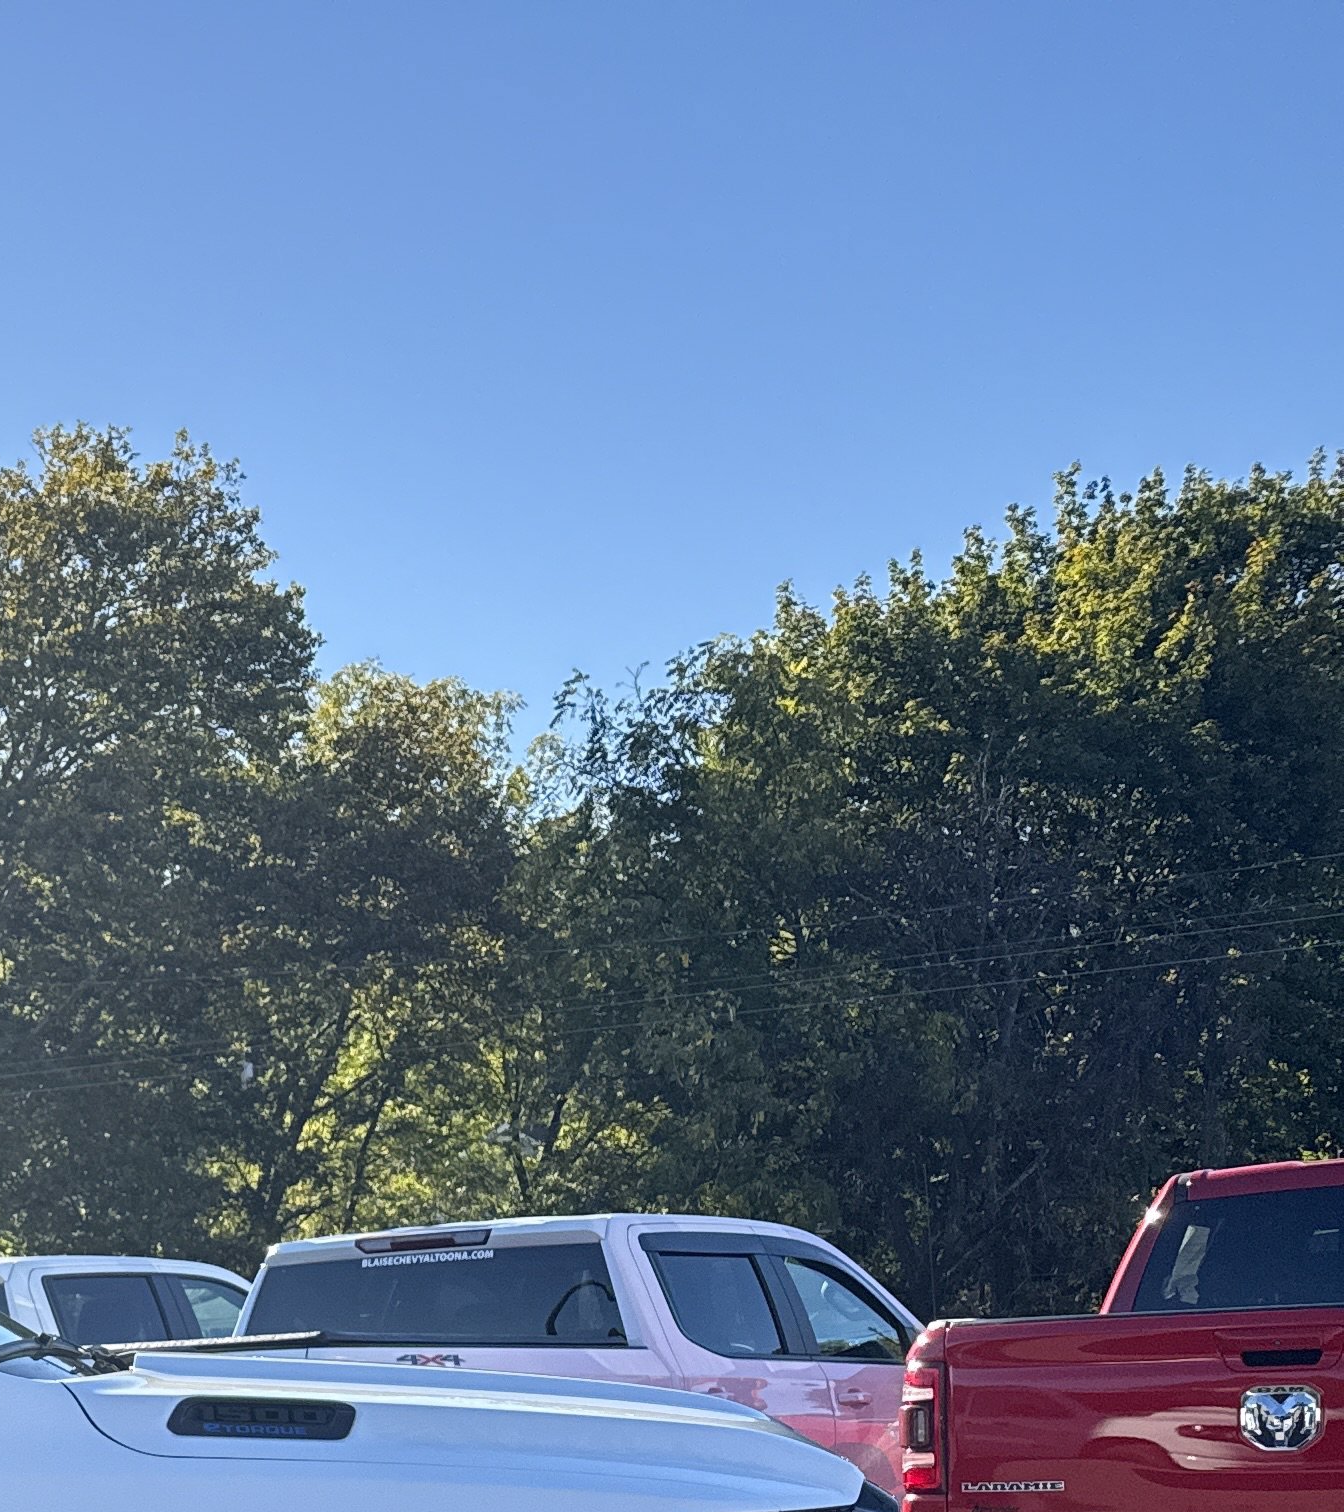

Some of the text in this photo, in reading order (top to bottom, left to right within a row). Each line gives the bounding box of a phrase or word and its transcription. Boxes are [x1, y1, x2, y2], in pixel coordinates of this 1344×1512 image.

[361, 1249, 494, 1268] BLAISECHEVYALTOONA.COM
[194, 1404, 333, 1425] 1500
[961, 1480, 1065, 1493] LARAMIE
